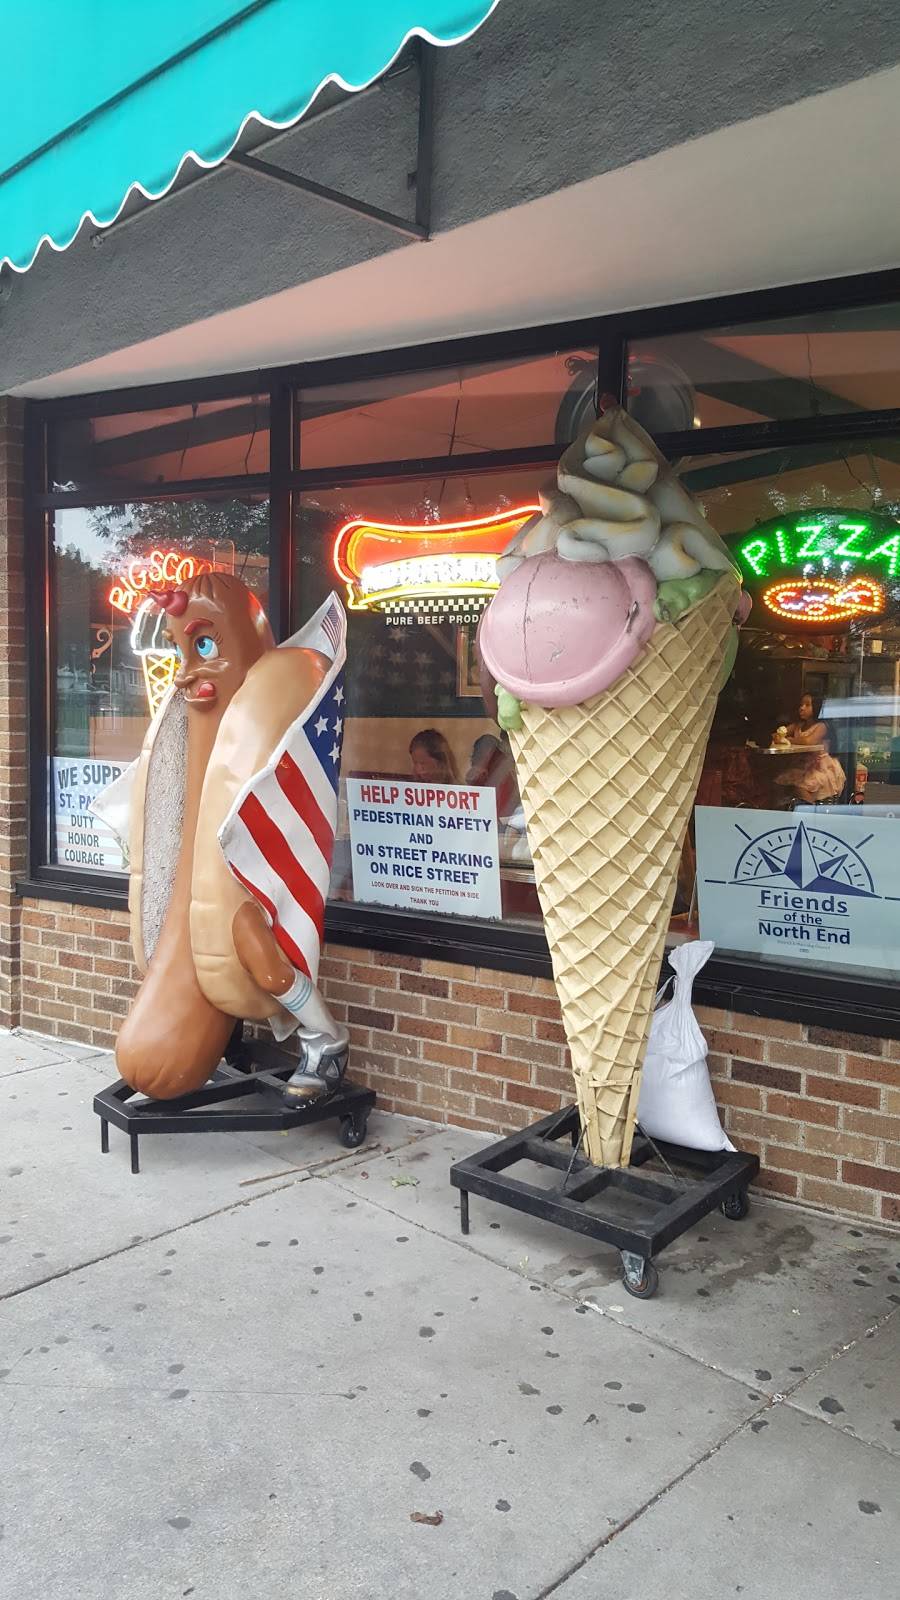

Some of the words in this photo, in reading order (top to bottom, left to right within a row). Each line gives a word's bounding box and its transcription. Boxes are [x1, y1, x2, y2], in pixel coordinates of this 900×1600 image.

[741, 524, 900, 575] PIZZA
[109, 560, 147, 613] BIG
[386, 616, 413, 625] PURE
[418, 615, 445, 624] BEEF
[449, 614, 482, 624] PROD
[58, 767, 78, 789] WE
[83, 764, 126, 785] SUPP
[60, 793, 75, 809] ST.
[361, 785, 399, 804] HELP
[404, 787, 480, 811] SUPPORT
[71, 814, 95, 829] DUTY
[353, 809, 434, 828] PEDESTRIAN
[438, 816, 492, 832] SAFETY
[68, 832, 99, 847] HONOR
[409, 833, 433, 845] AND
[65, 849, 105, 866] COURAGE
[356, 844, 374, 857] ON
[378, 845, 427, 862] STREET
[432, 851, 493, 869] PARKING
[370, 862, 388, 875] ON
[392, 864, 423, 879] RICE
[426, 868, 479, 885] STREET
[385, 882, 399, 890] OVER
[411, 885, 424, 893] SIGN
[435, 888, 459, 897] PETITION
[410, 897, 428, 905] THANK
[760, 889, 848, 914] Friends
[783, 912, 798, 922] of
[801, 913, 823, 925] the
[758, 922, 810, 940] North
[817, 928, 850, 945] End
